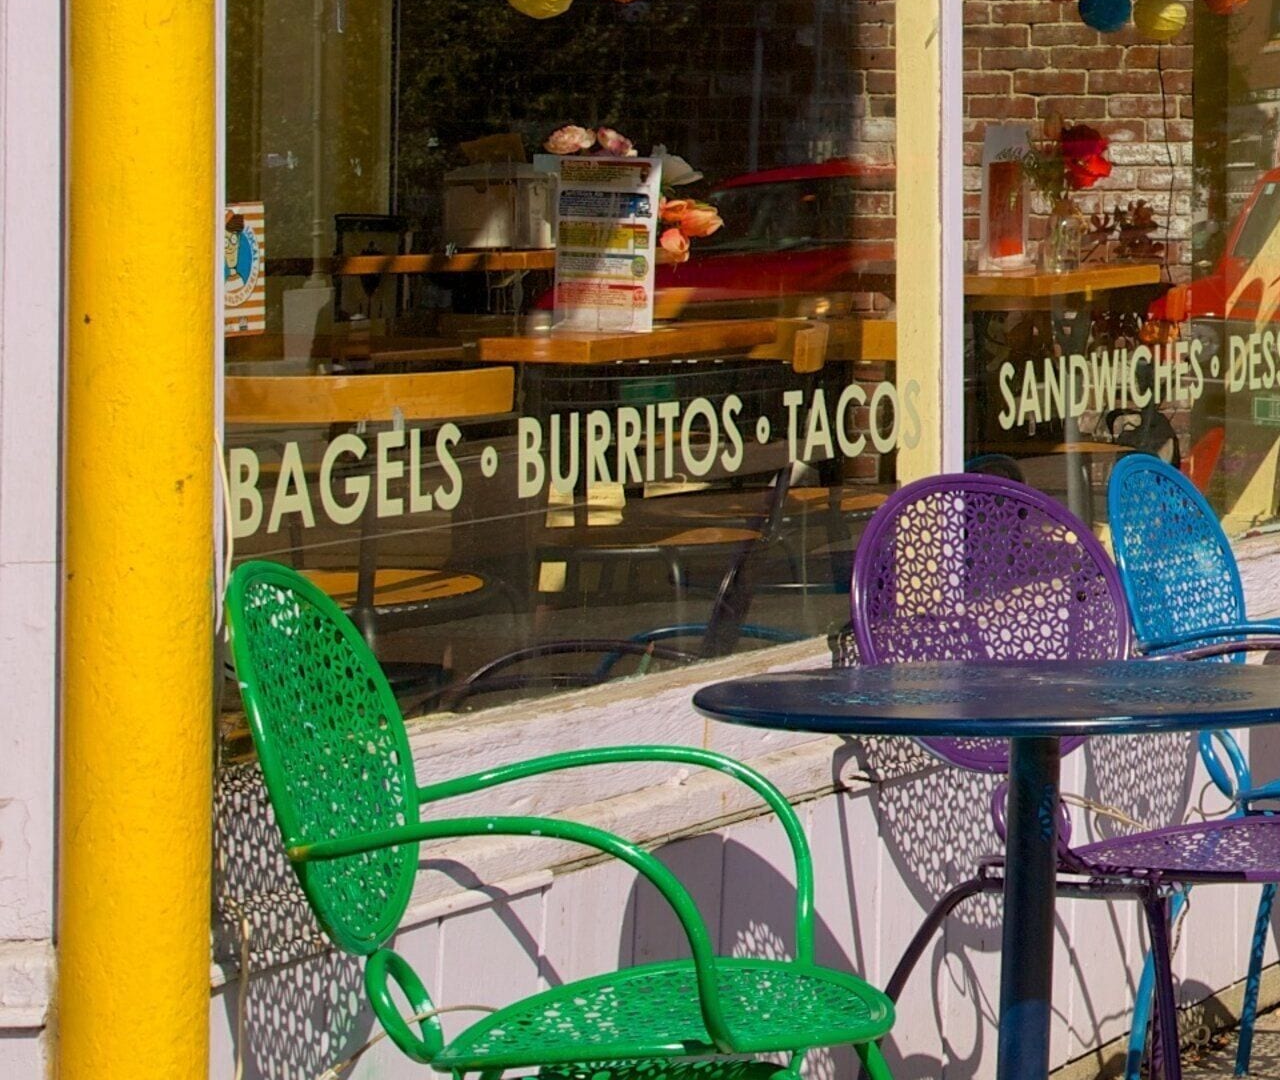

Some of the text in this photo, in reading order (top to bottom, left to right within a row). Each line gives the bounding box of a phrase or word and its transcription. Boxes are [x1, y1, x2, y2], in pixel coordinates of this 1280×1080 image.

[999, 339, 1204, 430] SANDWICHES
[229, 379, 921, 539] BAGELS BURRITOS TACOS
